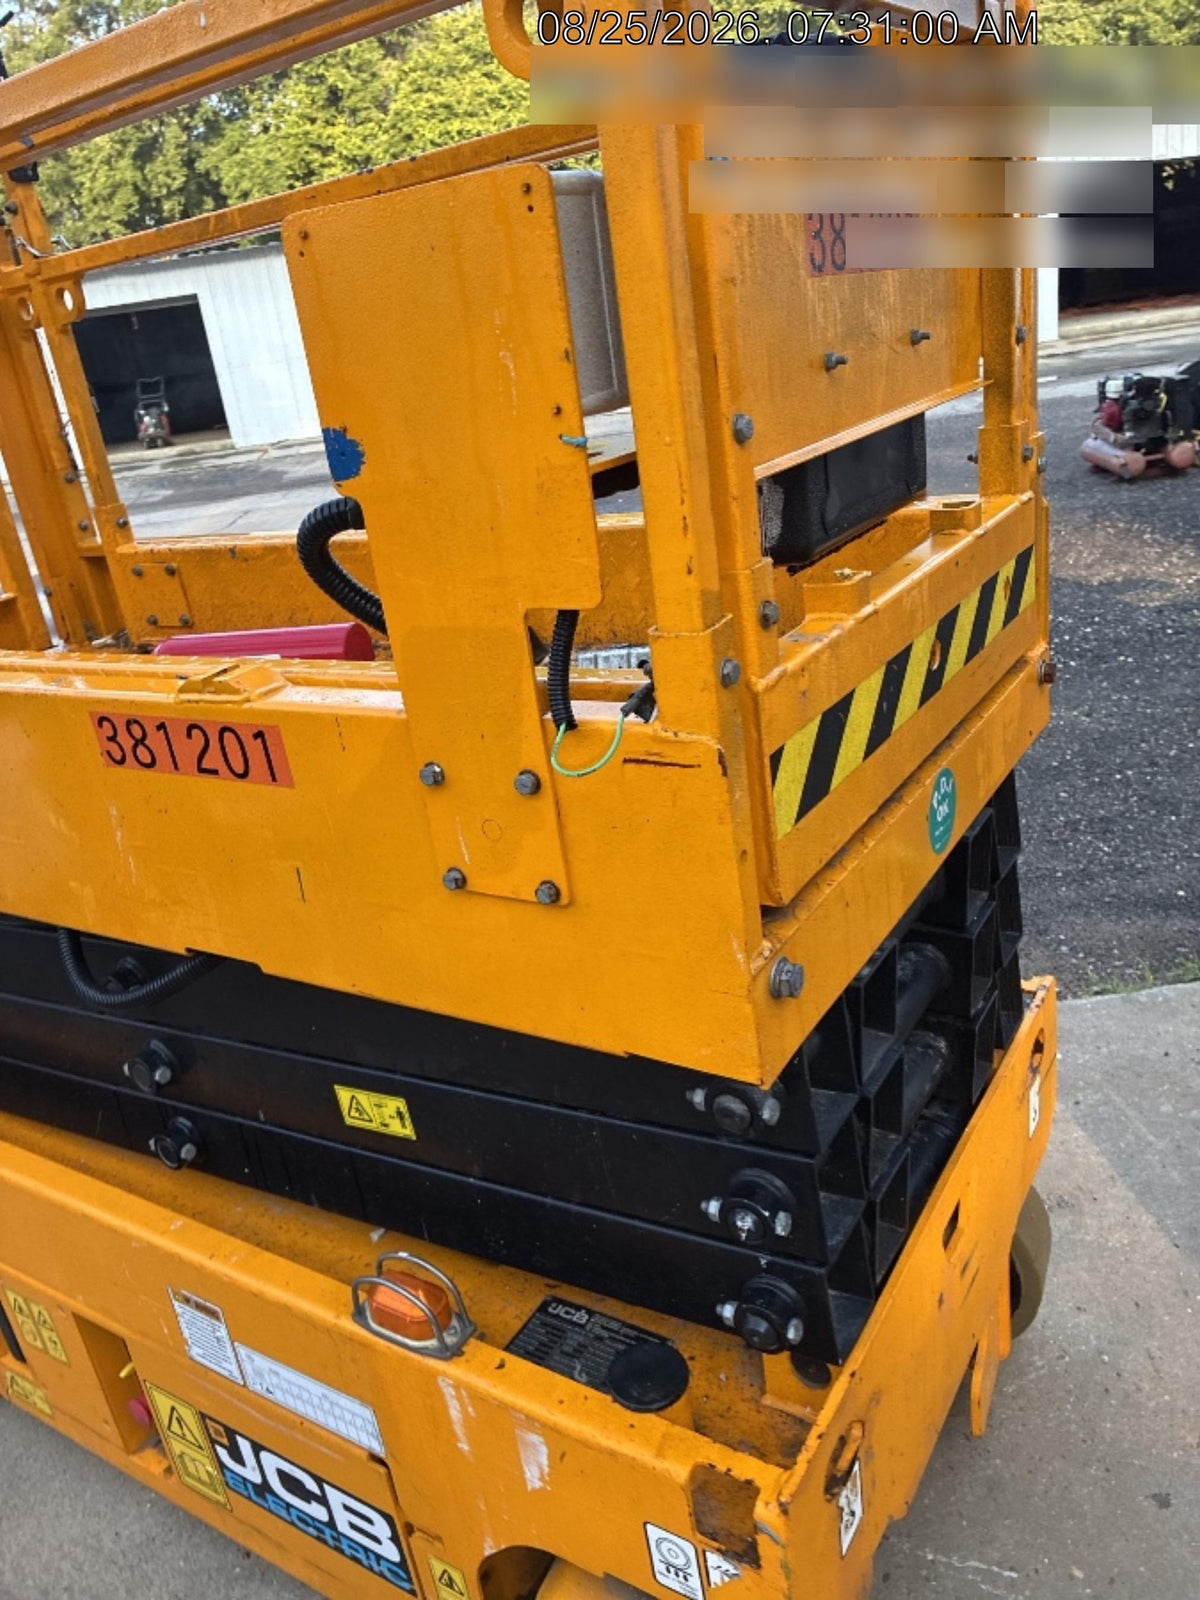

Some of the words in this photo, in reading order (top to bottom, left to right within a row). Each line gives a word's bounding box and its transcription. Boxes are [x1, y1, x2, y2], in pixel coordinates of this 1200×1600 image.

[97, 715, 278, 783] 381201
[547, 1302, 590, 1325] JCB
[214, 1433, 401, 1563] JCB
[223, 1467, 416, 1591] ELECTRIC
